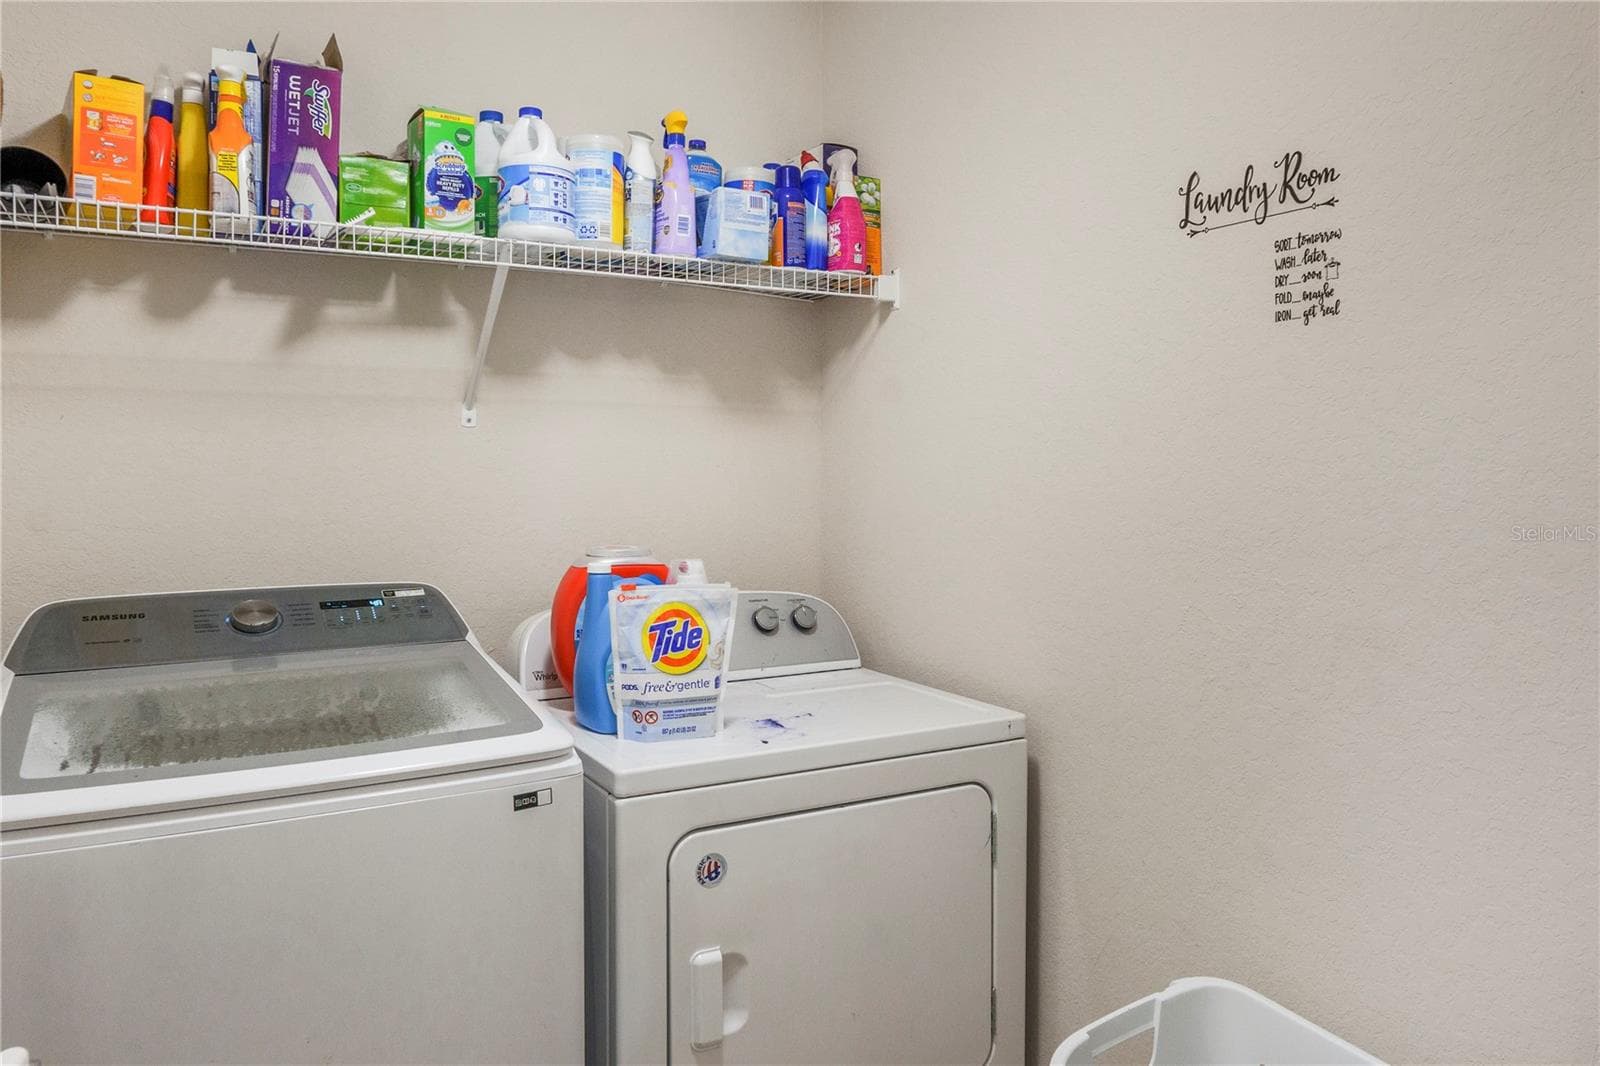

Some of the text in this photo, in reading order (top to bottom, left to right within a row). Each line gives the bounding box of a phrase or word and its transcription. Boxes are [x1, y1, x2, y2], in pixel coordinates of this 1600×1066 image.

[288, 75, 301, 135] WETJET
[307, 79, 331, 136] Swiffer
[1178, 150, 1341, 230] Laundry Room
[1274, 228, 1342, 253] SORT tomorrow
[1274, 248, 1328, 271] WASH later
[1274, 270, 1323, 288] DRY soon
[1274, 282, 1335, 305] FOLD maybe
[1274, 299, 1341, 326] IRON get real
[82, 612, 146, 622] SAMSUNG
[648, 618, 703, 663] Tide
